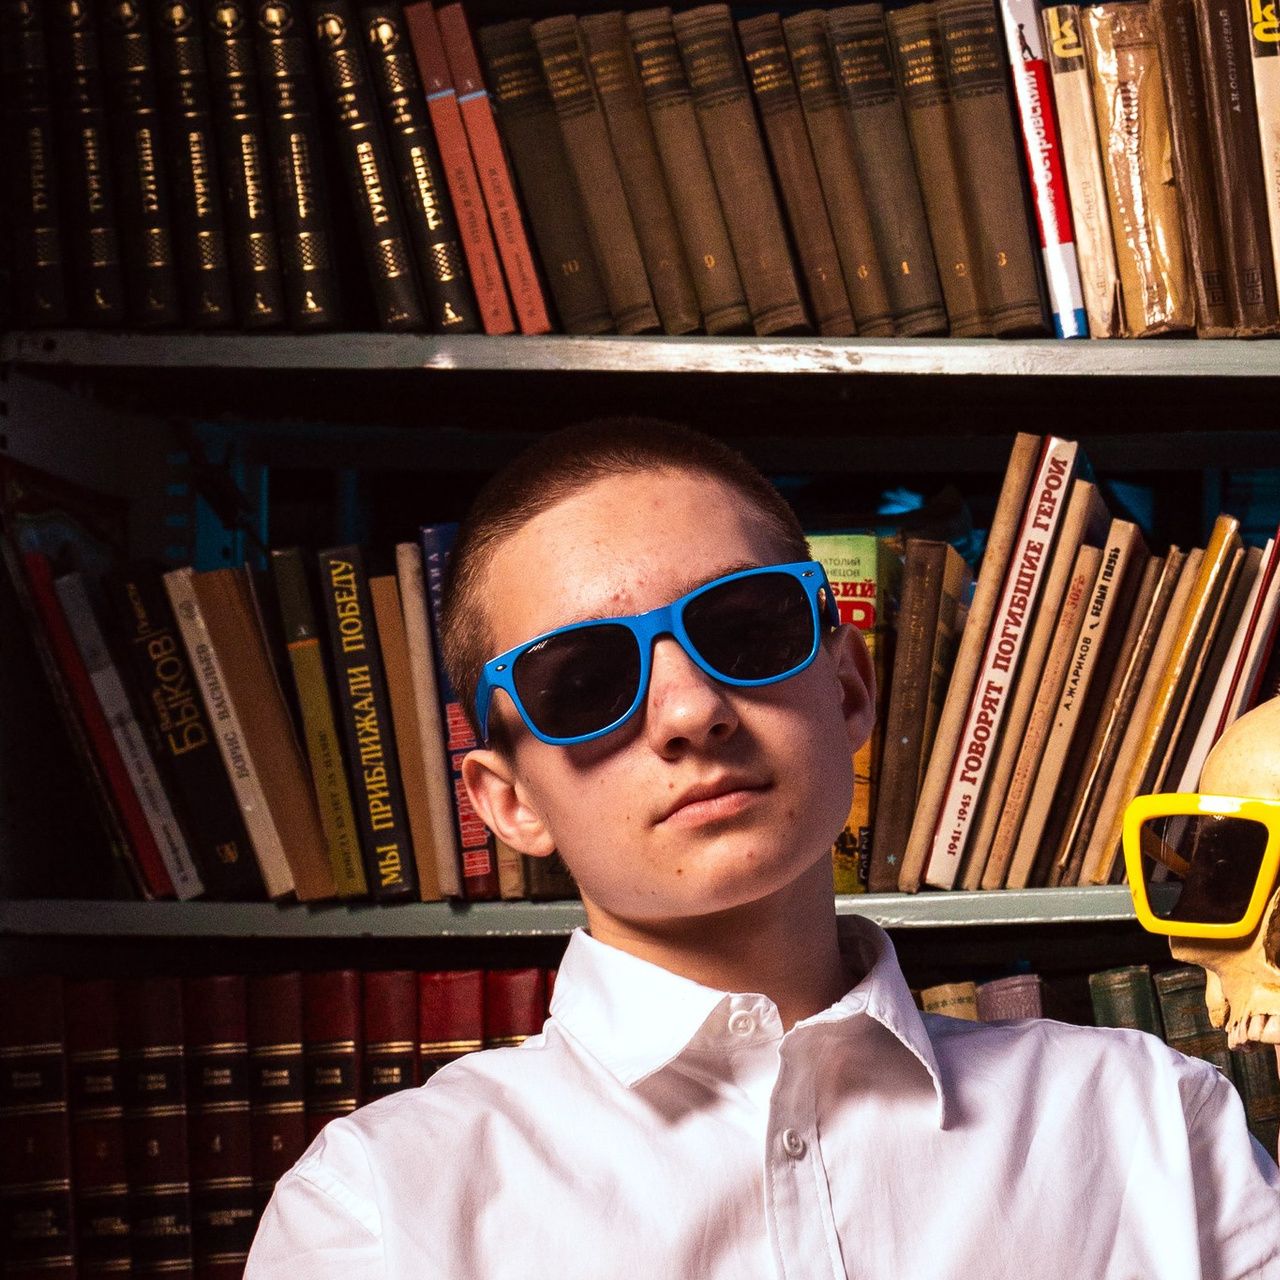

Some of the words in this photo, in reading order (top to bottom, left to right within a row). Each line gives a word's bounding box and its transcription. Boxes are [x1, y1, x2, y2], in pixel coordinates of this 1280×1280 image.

[27, 123, 45, 211] ТУРГЕНЕВ
[83, 126, 103, 214] ТУРГЕНЕВ
[137, 126, 157, 214] ТУРГЕНЕВ
[189, 131, 210, 219] ТУРГЕНЕВ
[241, 130, 263, 219] ТУРГЕНЕВ
[291, 130, 313, 219] ТУРГЕНЕВ
[354, 139, 390, 228] ТУРГЕНЕВ
[408, 144, 445, 232] ТУРГЕНЕВ
[703, 254, 716, 270] 9
[900, 260, 911, 275] 1
[996, 252, 1008, 267] 3
[822, 556, 861, 567] АТОЛИЙ
[1089, 582, 1109, 617] БЕЛЫЙ
[1100, 545, 1121, 582] ГОЛУБЬ
[329, 559, 367, 653] ПОБЕДУ
[958, 678, 1005, 786] ГОВОРЯТ
[990, 537, 1045, 673] ПОГИБШИЕ
[1031, 454, 1069, 533] ГЕРОИ
[195, 642, 230, 722] ВАСИЛЬЕВ
[223, 730, 250, 780] БОРИС
[348, 664, 394, 832] ПРИБЛИЖАЛИ
[374, 843, 403, 888] МЫ
